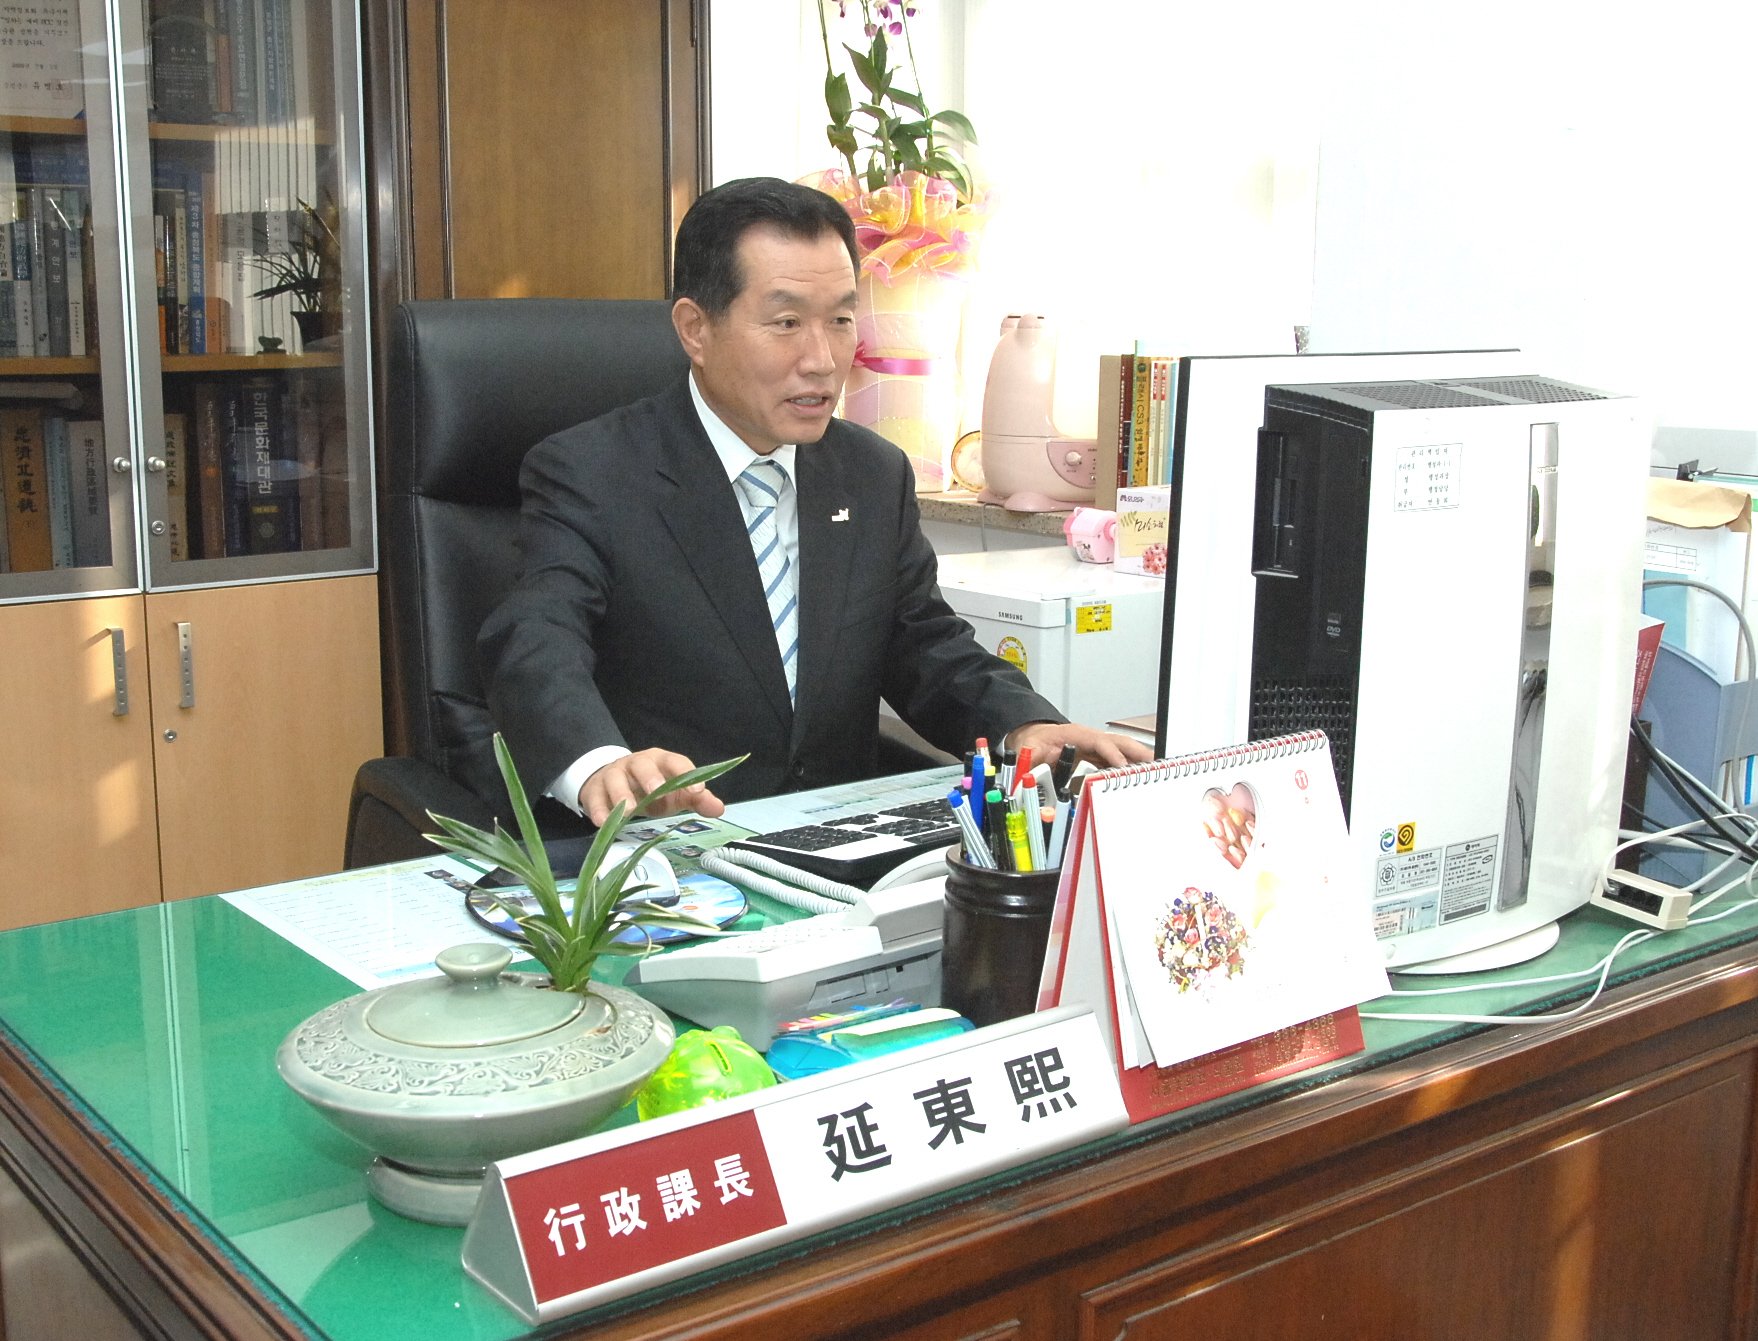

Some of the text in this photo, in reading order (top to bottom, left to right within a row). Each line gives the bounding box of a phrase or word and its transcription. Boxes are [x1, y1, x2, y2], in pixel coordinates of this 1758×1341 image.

[191, 263, 203, 295] 종합계획
[1136, 404, 1145, 425] CS3
[252, 391, 274, 495] 한국문화재대관
[998, 611, 1024, 622] SAMSUNG
[1326, 626, 1341, 634] DVD
[817, 1047, 1078, 1183] 延東熙
[543, 1153, 755, 1258] 行政課長
